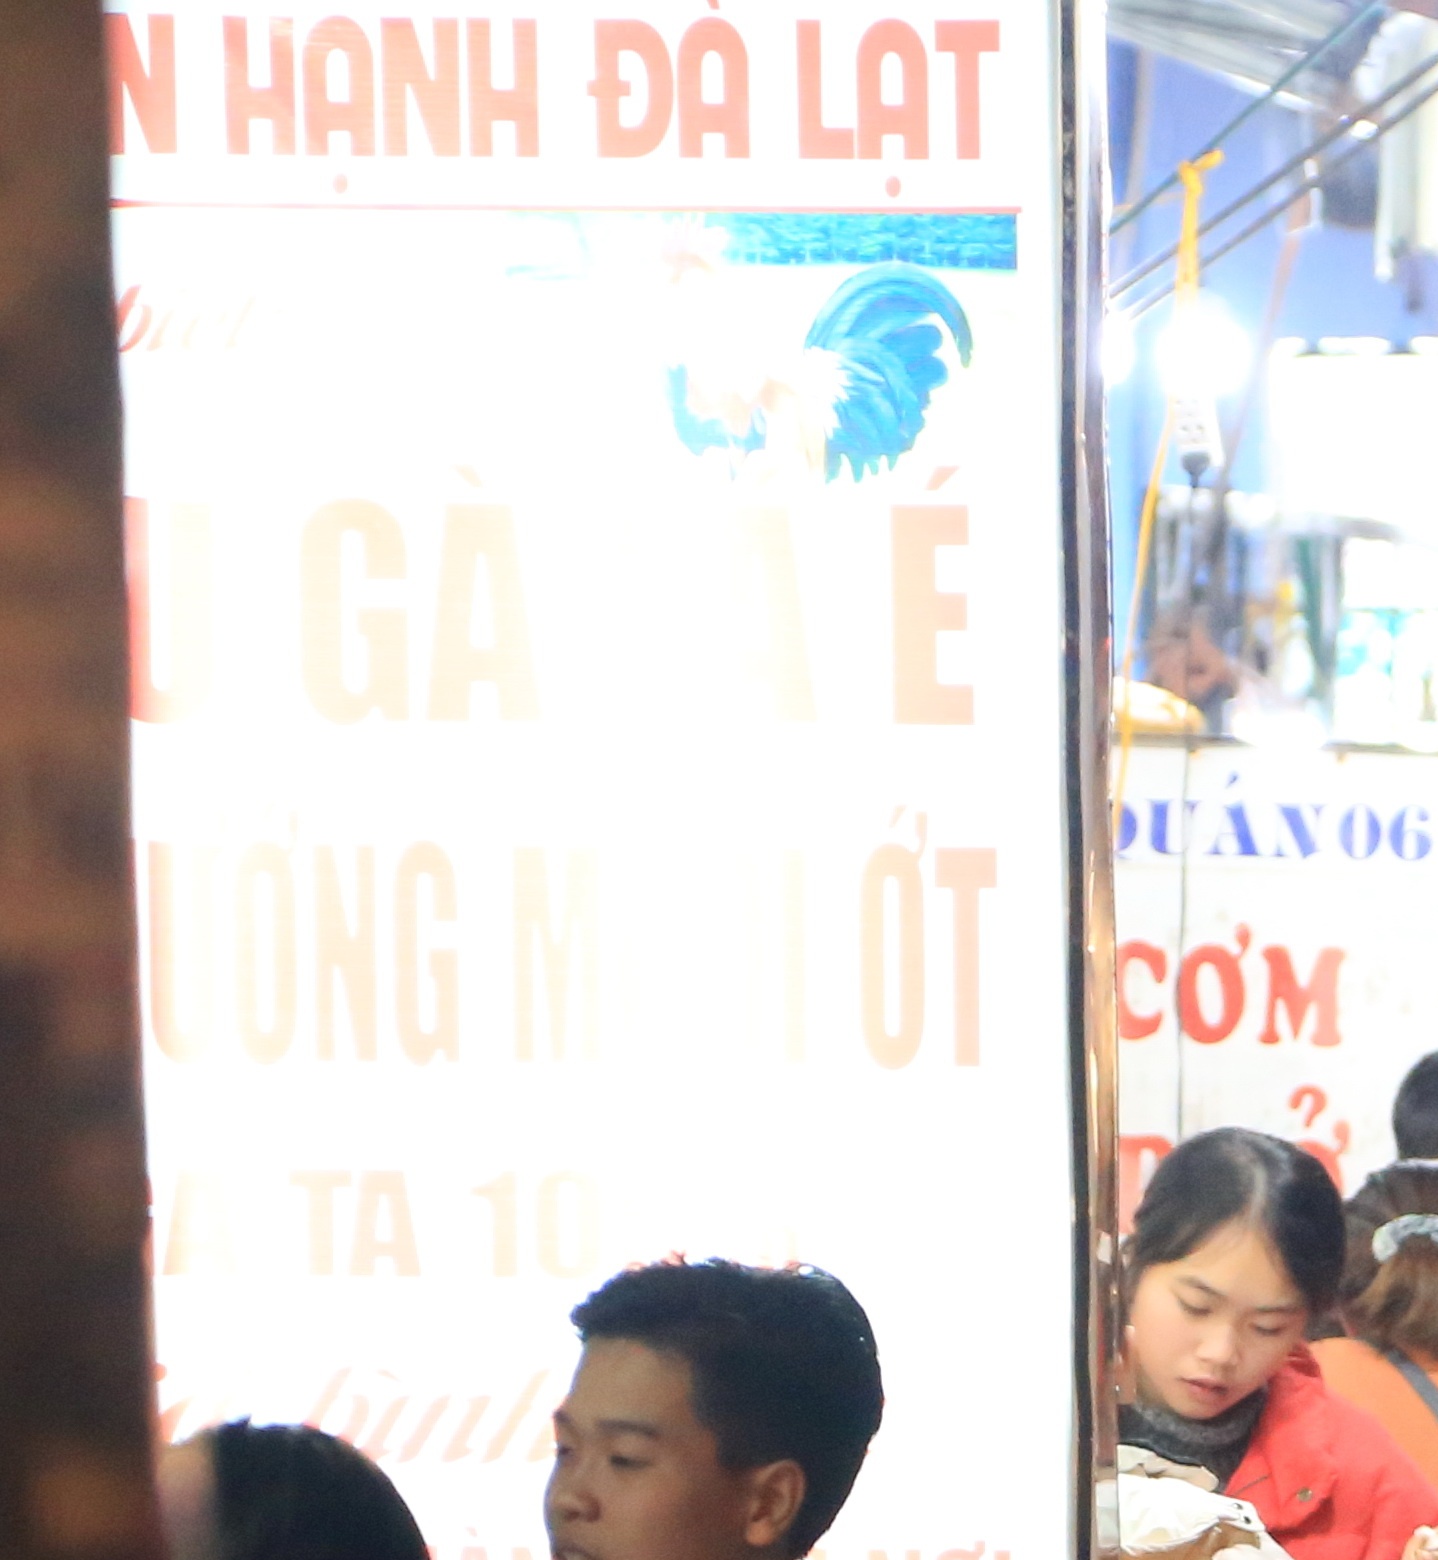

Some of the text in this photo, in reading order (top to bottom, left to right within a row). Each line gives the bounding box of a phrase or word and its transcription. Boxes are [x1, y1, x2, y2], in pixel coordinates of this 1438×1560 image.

[222, 14, 540, 194] HẠNH
[587, 0, 751, 158] ĐÀ
[796, 17, 1000, 198] LẠT
[298, 464, 544, 726] GÀ
[888, 464, 976, 727] É
[1117, 922, 1346, 1047] CƠM
[289, 1170, 421, 1278] TA
